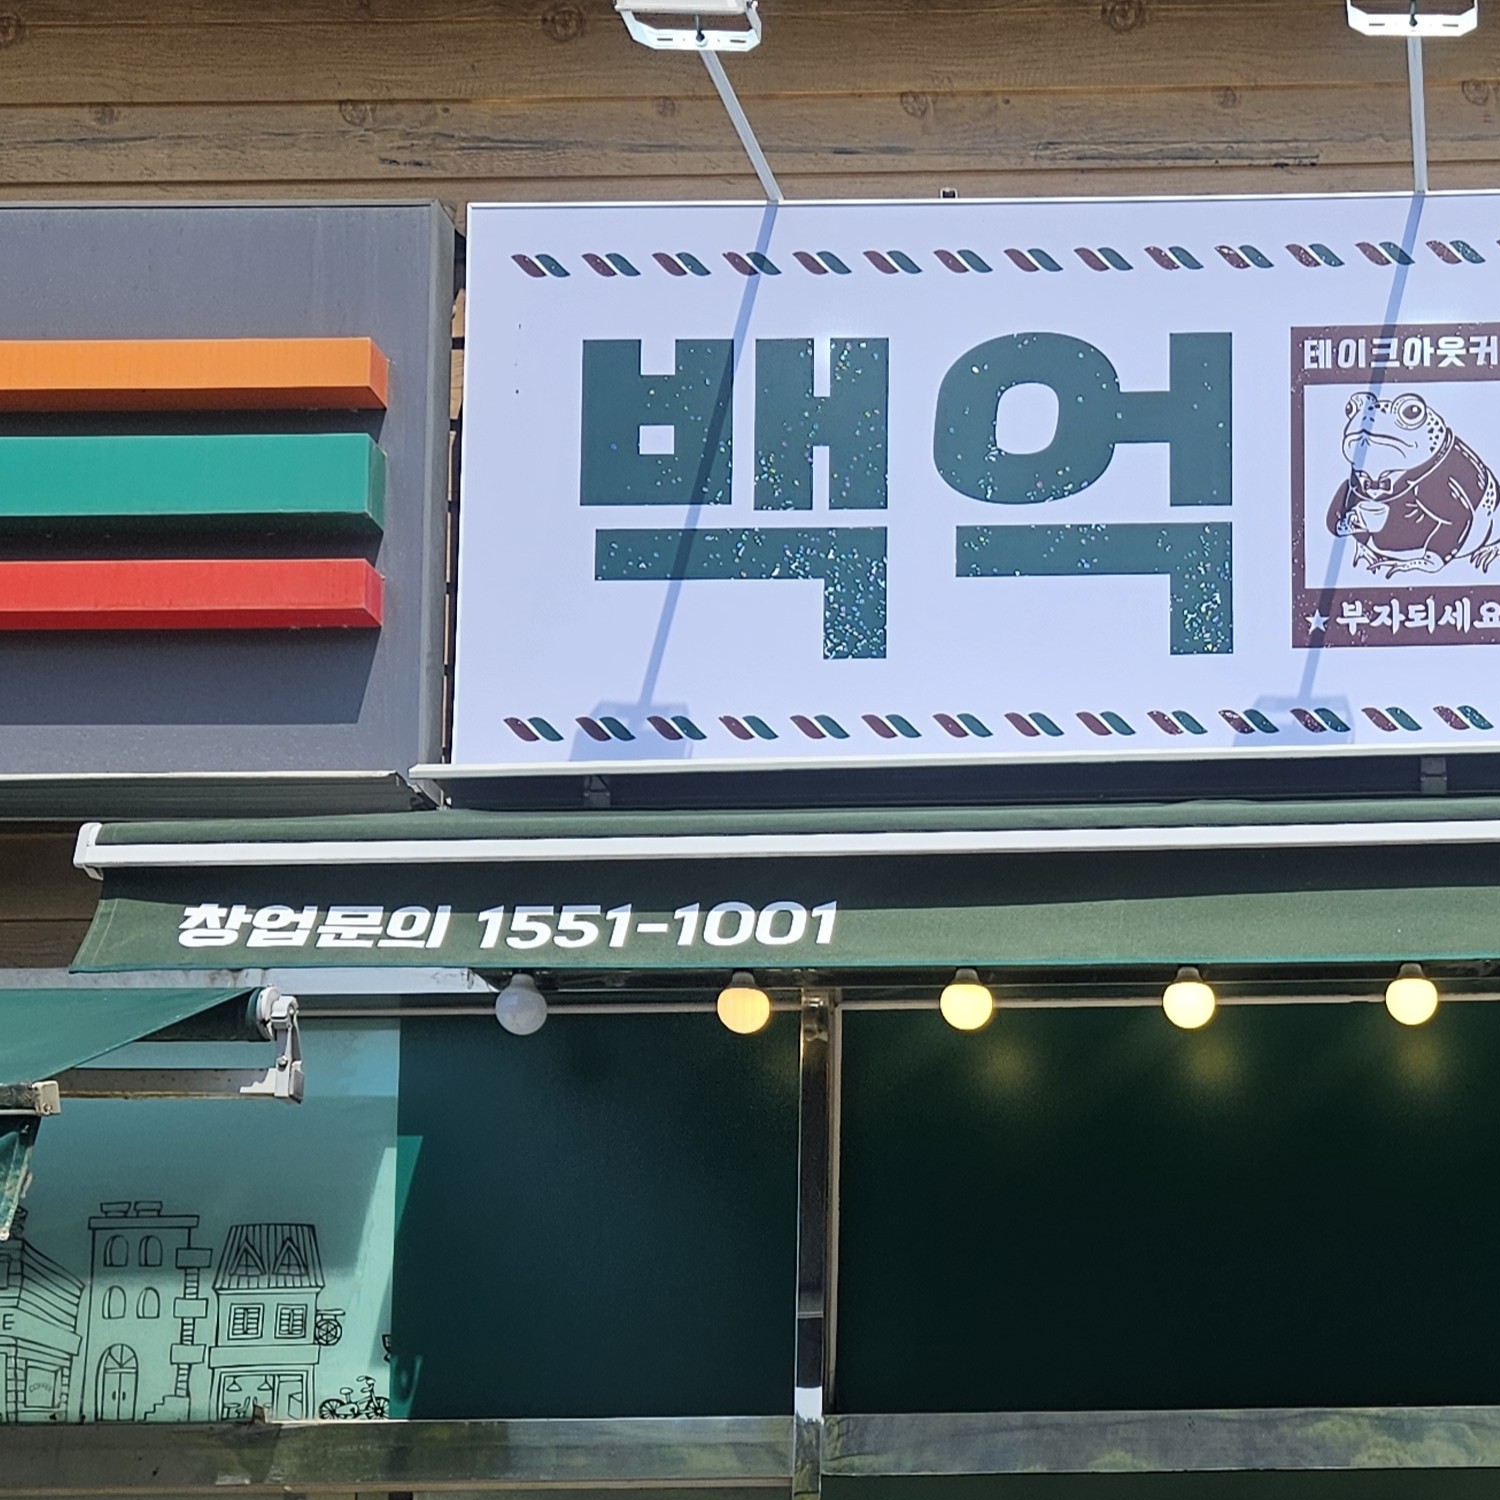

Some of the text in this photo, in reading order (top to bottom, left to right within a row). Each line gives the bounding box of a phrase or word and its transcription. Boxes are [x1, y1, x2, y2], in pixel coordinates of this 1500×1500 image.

[580, 331, 1234, 659] 백억
[178, 901, 838, 949] 창업문의 1551-1001
